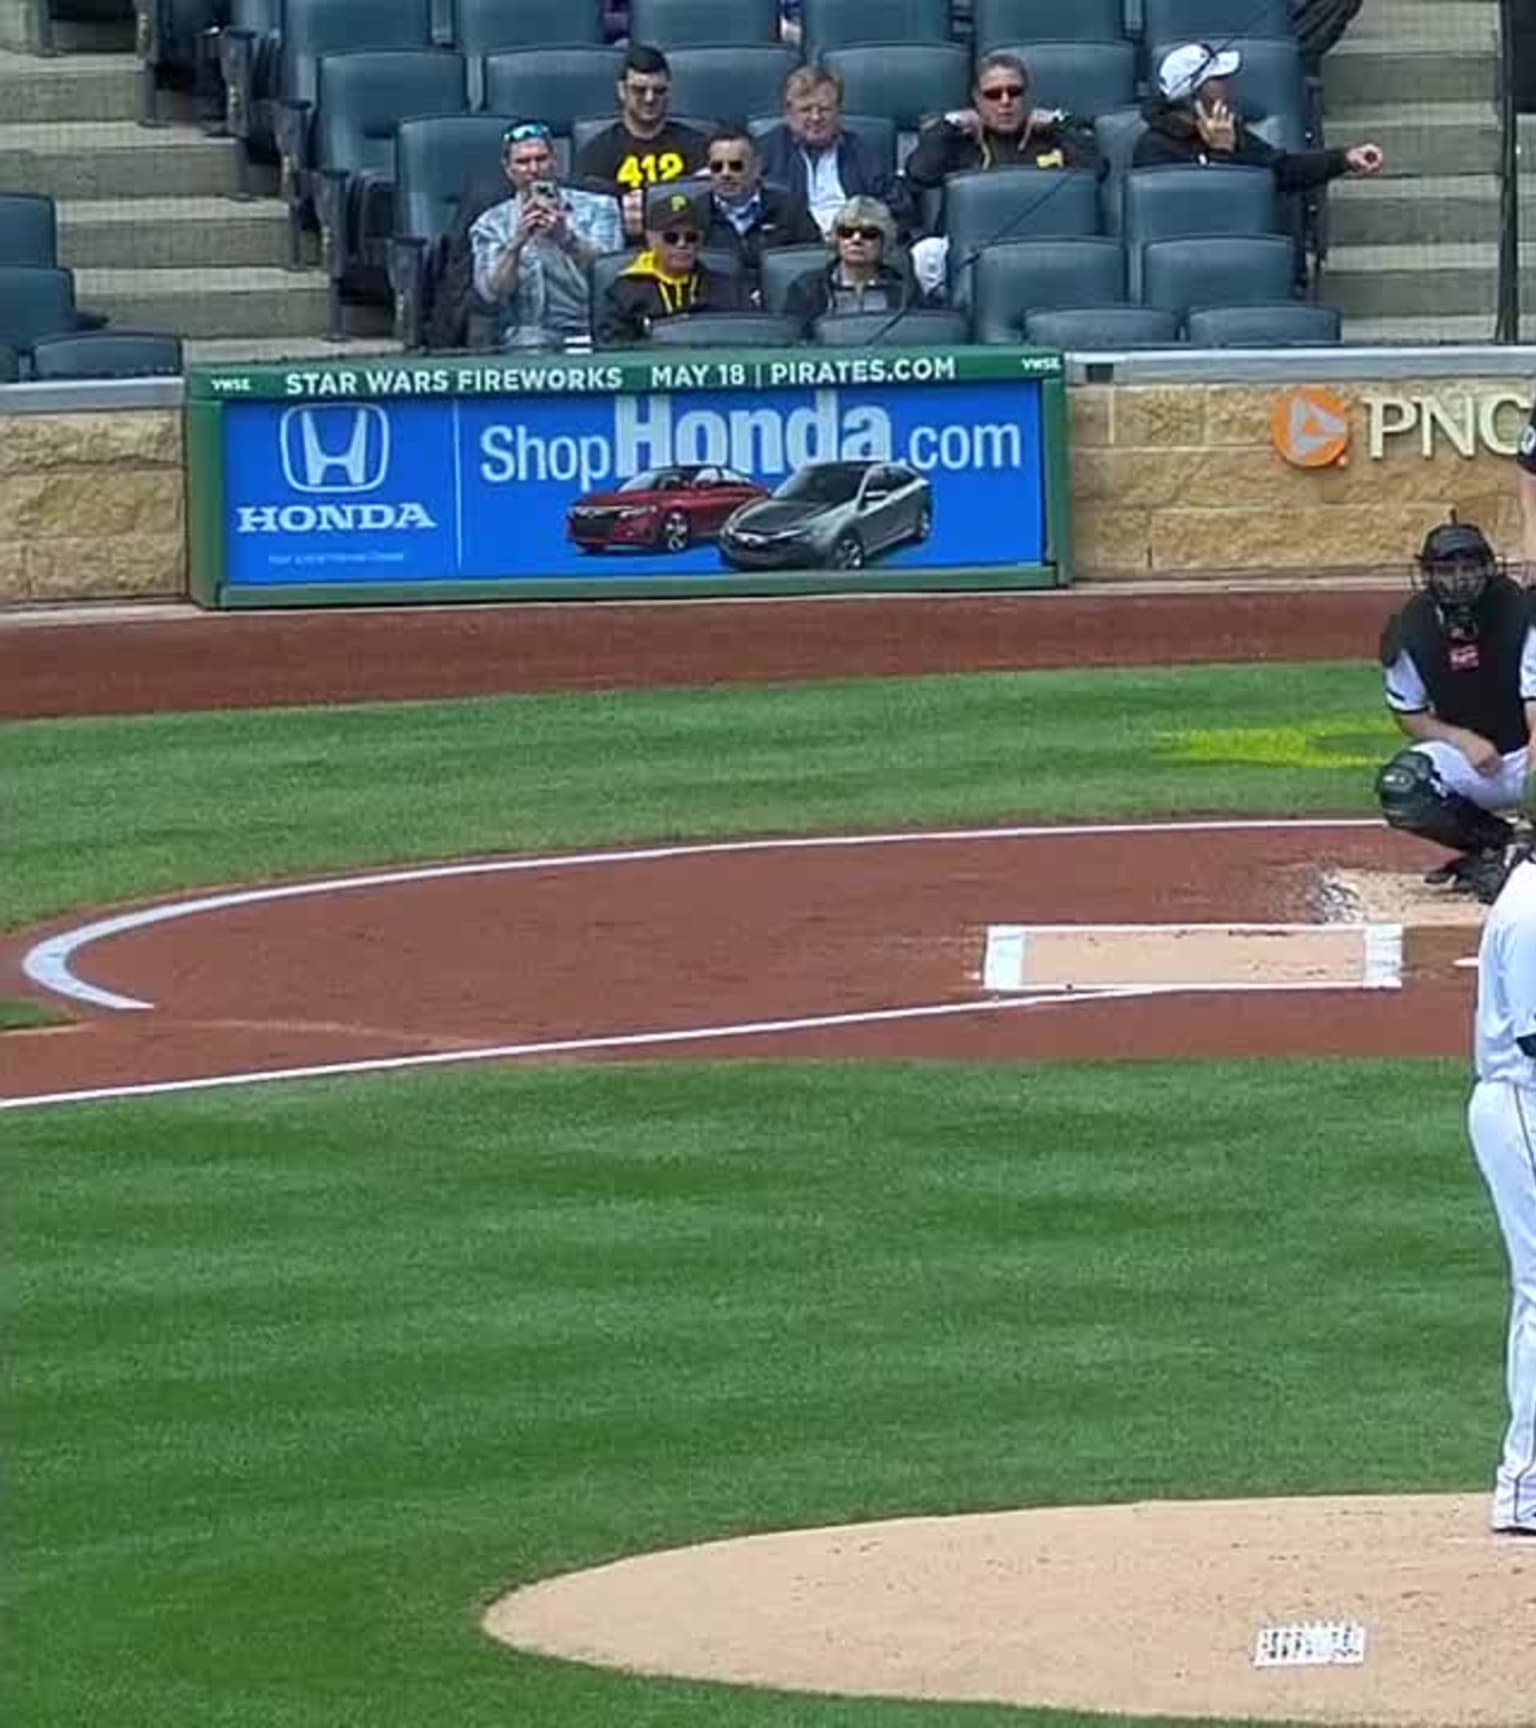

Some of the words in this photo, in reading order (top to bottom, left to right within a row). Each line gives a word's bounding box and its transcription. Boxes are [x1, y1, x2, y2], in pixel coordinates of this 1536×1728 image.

[287, 373, 356, 395] STAR
[365, 369, 448, 393] WARS
[459, 367, 623, 391] FIREWORKS
[652, 363, 706, 387] MAY
[718, 363, 745, 385] 18
[771, 357, 956, 384] PIRATES.COM
[1361, 393, 1531, 459] PNC
[236, 502, 437, 533] HONDA
